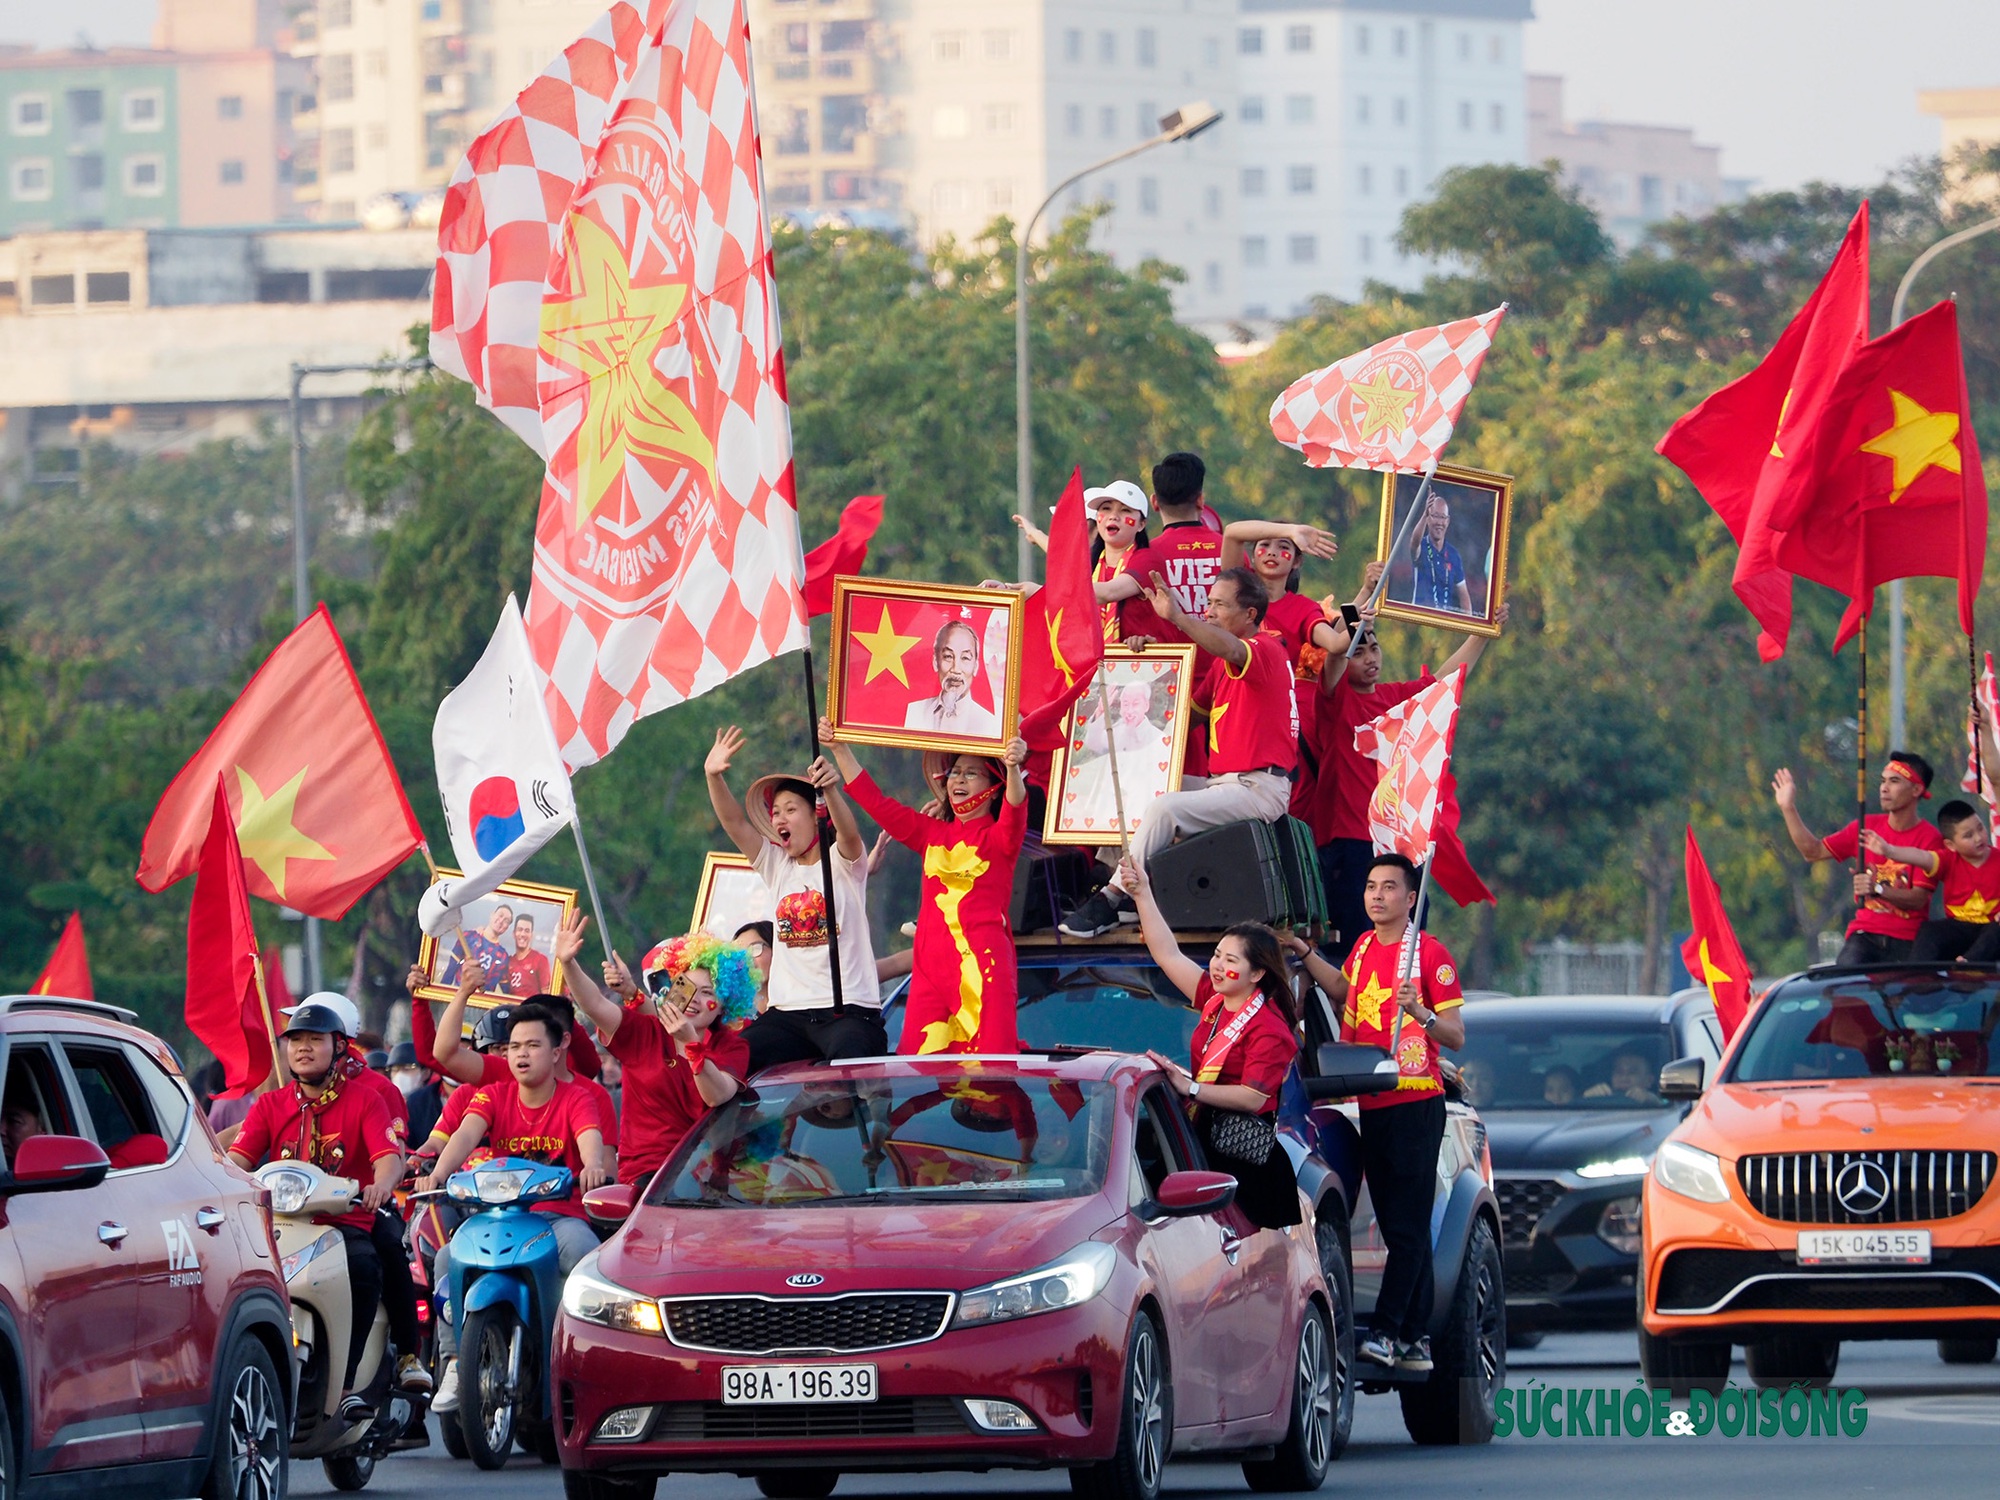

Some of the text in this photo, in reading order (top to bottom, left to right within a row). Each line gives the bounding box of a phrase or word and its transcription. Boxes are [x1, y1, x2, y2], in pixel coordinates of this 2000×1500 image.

[1165, 557, 1222, 586] VIE
[1169, 585, 1209, 613] NA
[511, 972, 522, 988] 22
[791, 1274, 818, 1284] KIA
[727, 1369, 871, 1400] 98A-196.39
